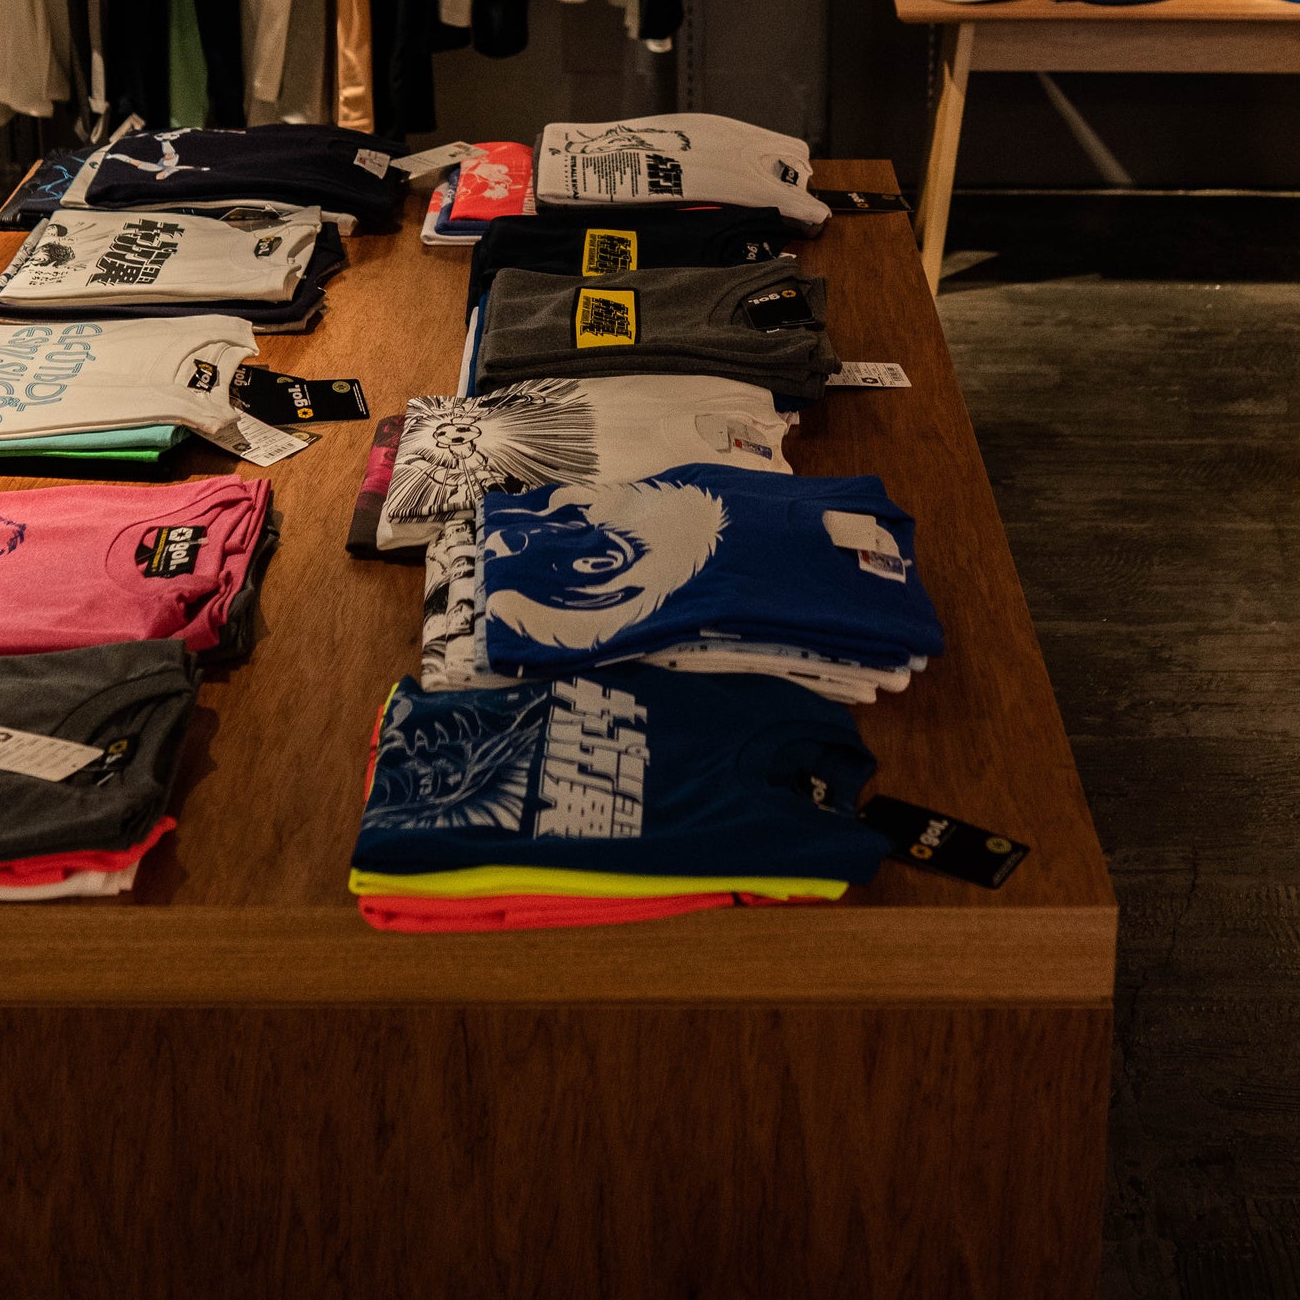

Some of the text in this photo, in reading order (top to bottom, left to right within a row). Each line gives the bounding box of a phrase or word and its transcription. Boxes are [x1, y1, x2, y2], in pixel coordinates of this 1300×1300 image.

[86, 219, 186, 287] キャプテン翼
[168, 541, 191, 571] gol.
